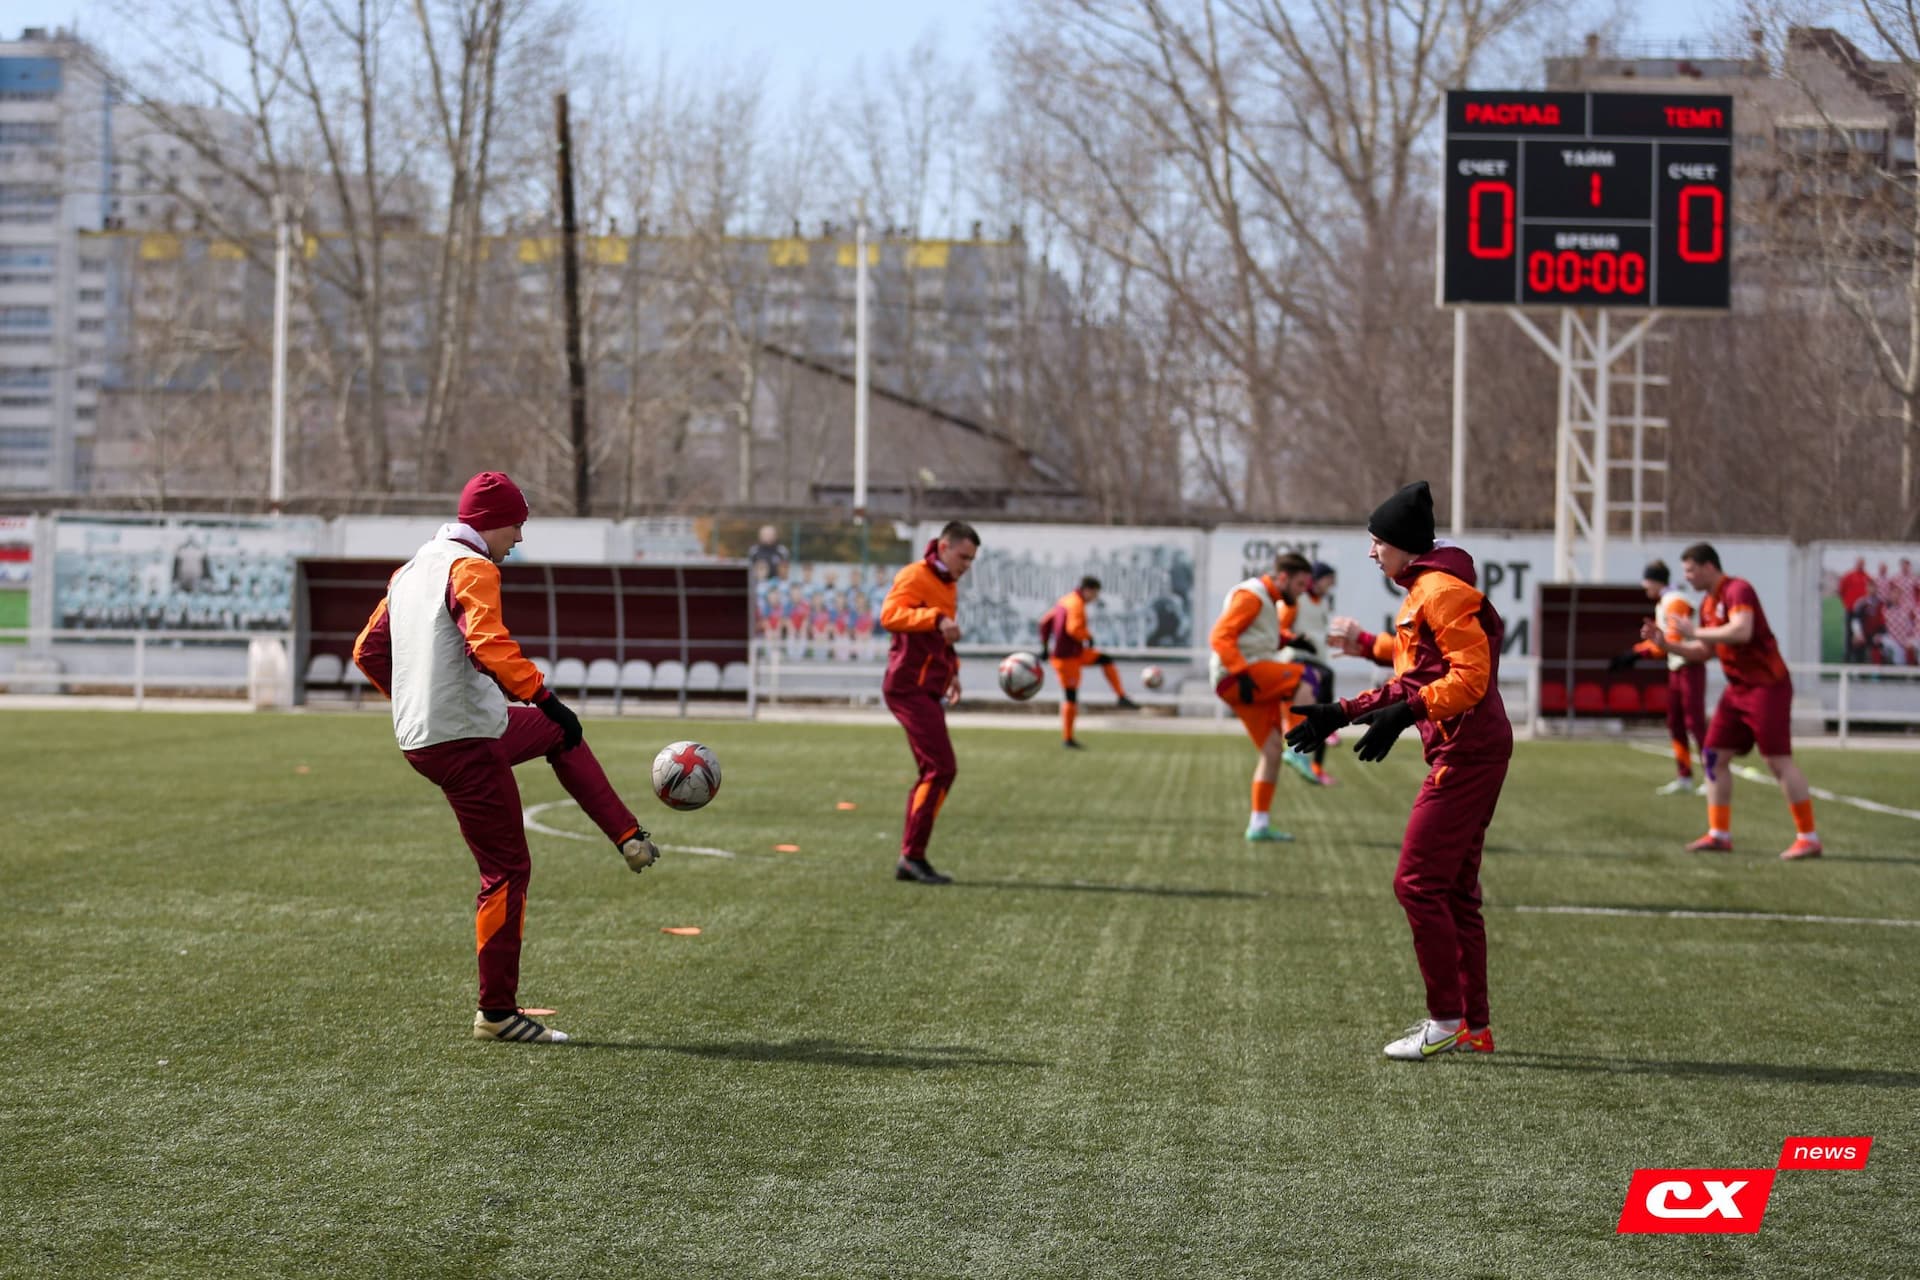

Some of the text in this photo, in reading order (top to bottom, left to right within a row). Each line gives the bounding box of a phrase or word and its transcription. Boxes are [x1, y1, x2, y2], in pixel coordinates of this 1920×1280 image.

[1465, 103, 1561, 125] РАСПАД
[1664, 106, 1723, 129] ТЕМП
[1457, 159, 1508, 177] СЧЕТ
[1667, 163, 1717, 180] СЧЕТ
[1468, 181, 1515, 260] 0
[1677, 185, 1724, 264] 0
[1555, 232, 1620, 250] ВРЕМЯ
[1528, 250, 1646, 295] 00:00
